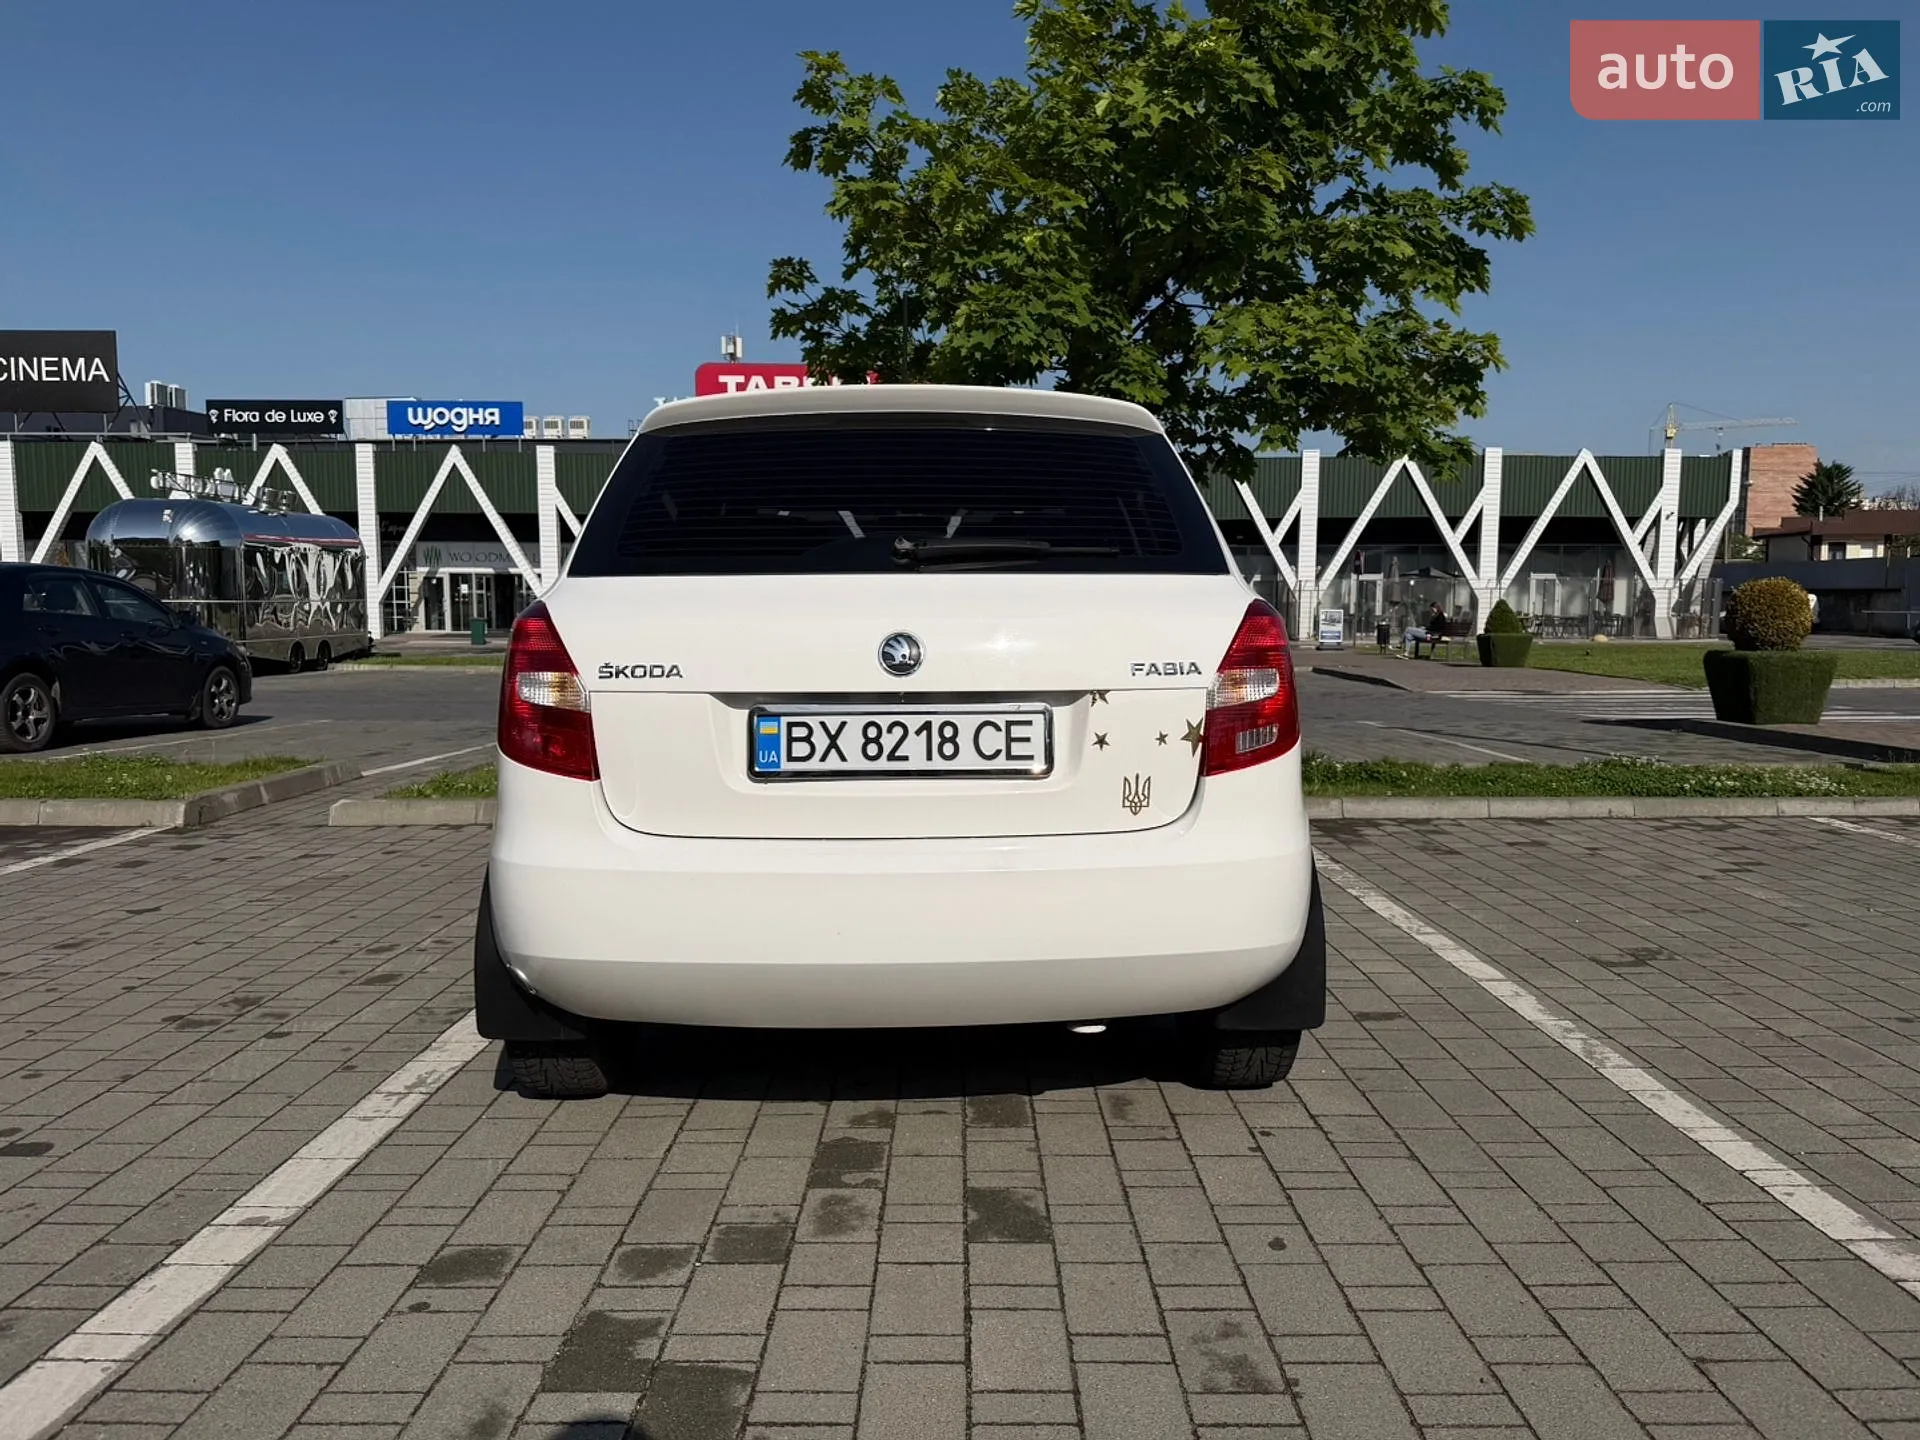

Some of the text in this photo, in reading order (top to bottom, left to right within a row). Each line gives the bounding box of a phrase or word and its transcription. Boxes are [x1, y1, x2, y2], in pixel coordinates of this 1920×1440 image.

[224, 408, 325, 423] Flora de Luxe
[598, 663, 683, 679] ŠKODA
[1131, 662, 1202, 676] FABIA
[786, 720, 1035, 762] BX 8218 CE
[759, 749, 778, 763] UA
